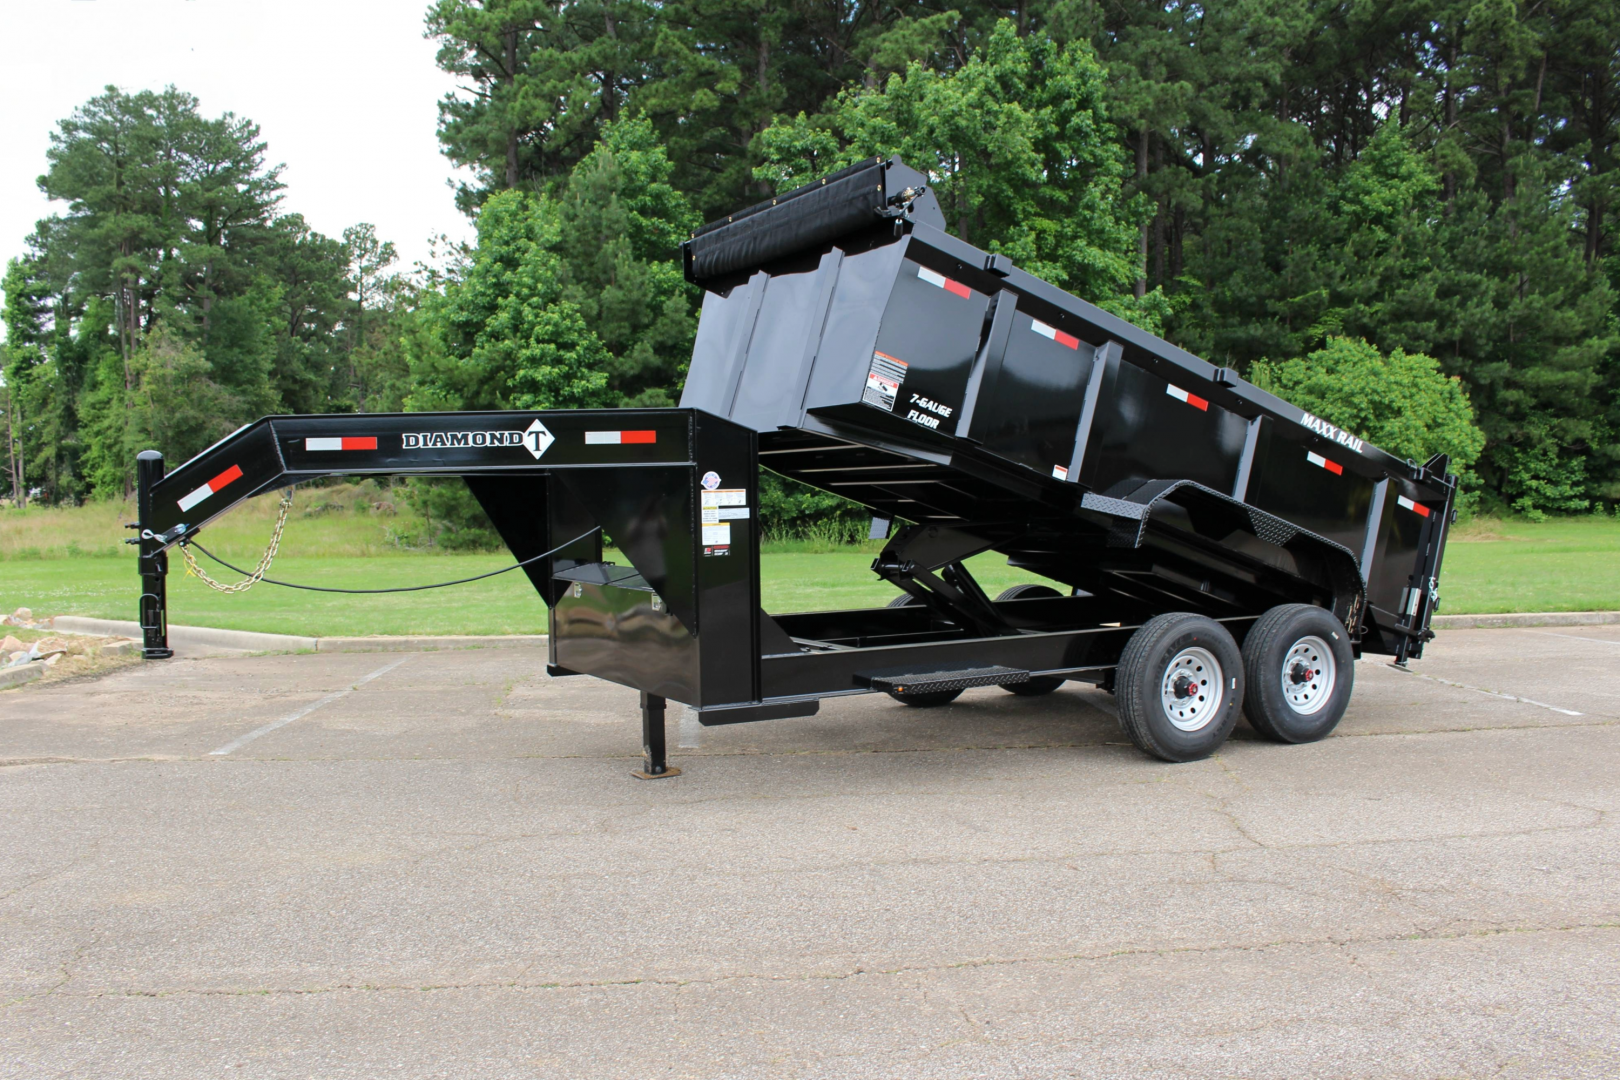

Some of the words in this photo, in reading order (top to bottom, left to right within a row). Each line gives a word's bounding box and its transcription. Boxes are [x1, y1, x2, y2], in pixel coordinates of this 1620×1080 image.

[909, 393, 953, 418] 7-GAUGE
[907, 409, 940, 429] FLOOR
[402, 431, 524, 449] DIAMOND
[1300, 412, 1338, 440] MAXX
[1336, 430, 1364, 454] RAIL
